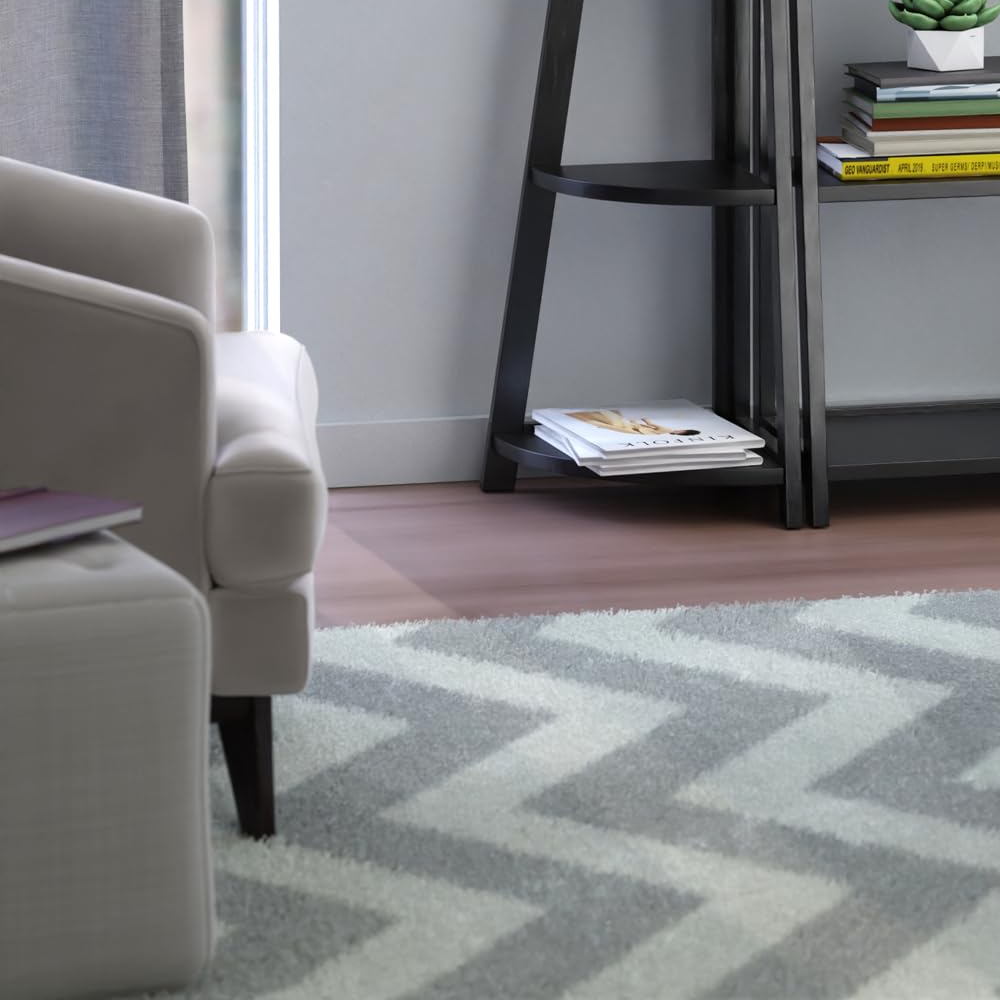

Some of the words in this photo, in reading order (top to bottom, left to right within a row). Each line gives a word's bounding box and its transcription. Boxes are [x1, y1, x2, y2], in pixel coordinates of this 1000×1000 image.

[845, 164, 855, 175] GEO
[856, 163, 890, 175] VANGUARDIST
[898, 163, 911, 173] APRIL
[931, 163, 948, 172] SUPER
